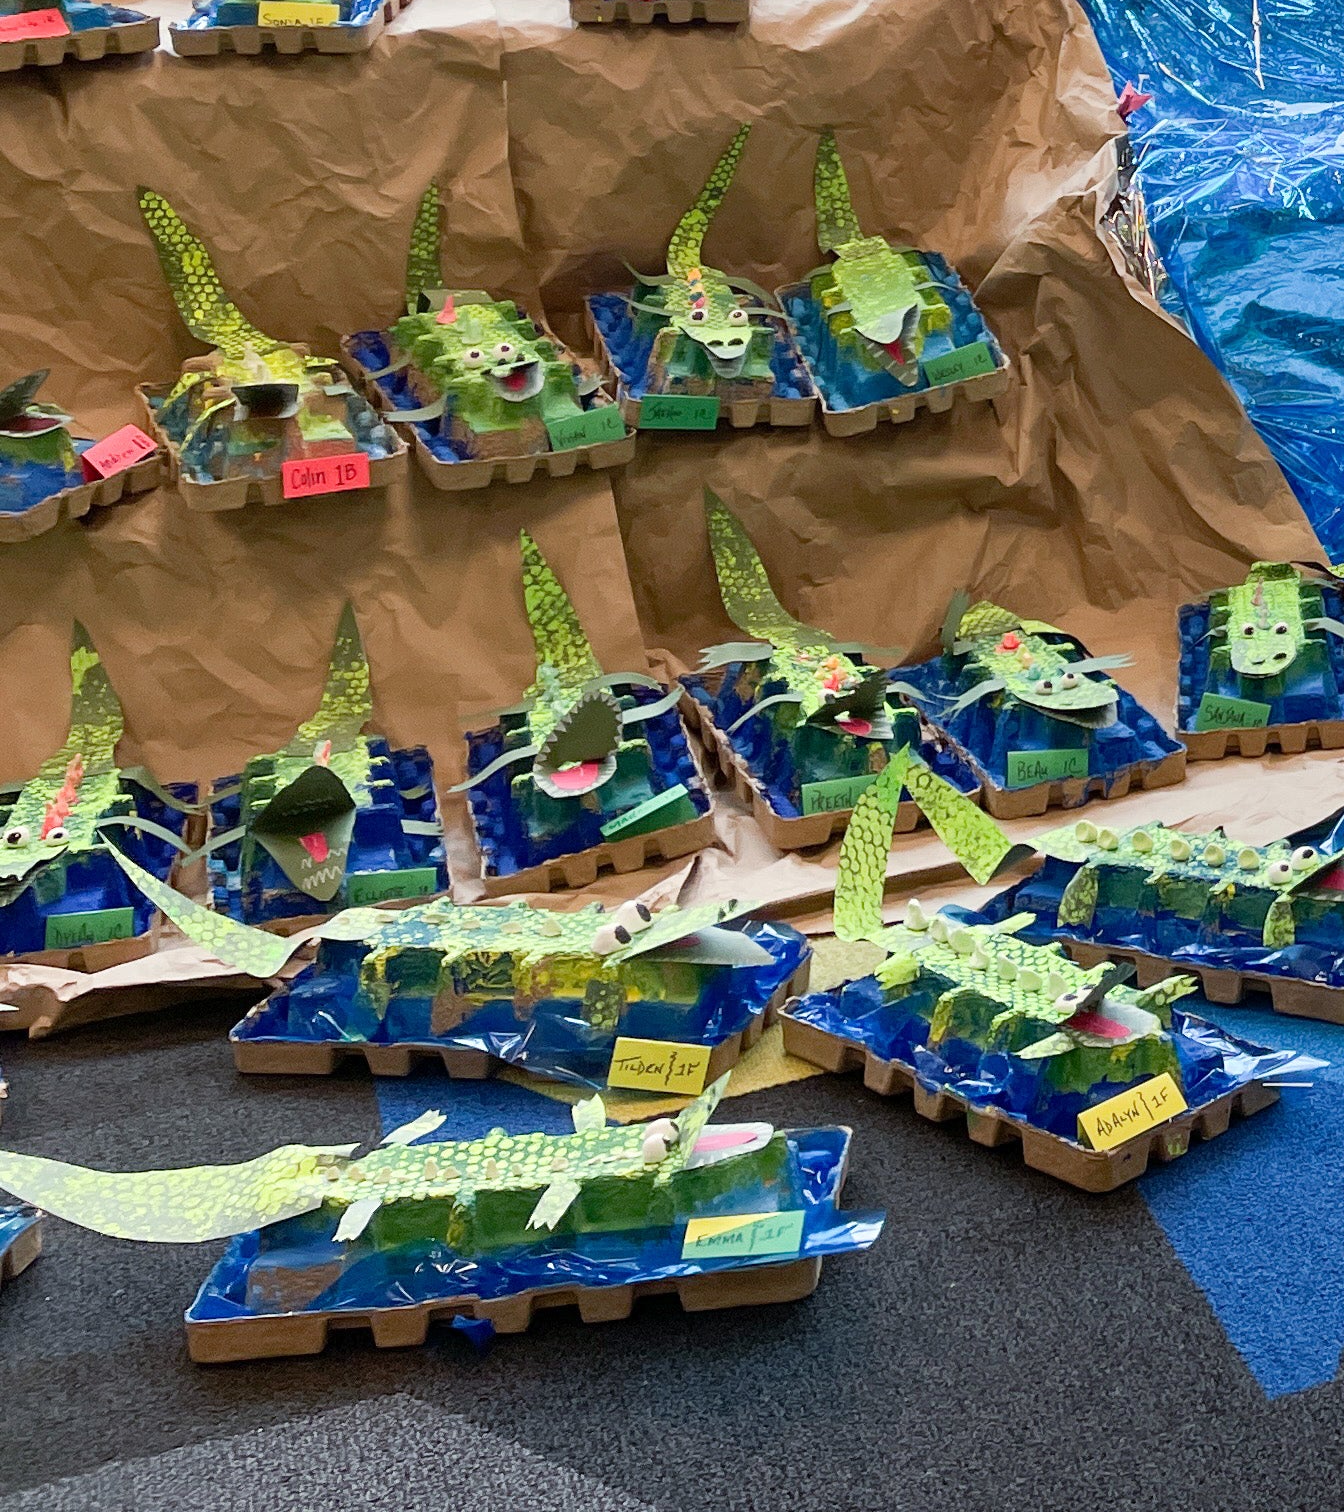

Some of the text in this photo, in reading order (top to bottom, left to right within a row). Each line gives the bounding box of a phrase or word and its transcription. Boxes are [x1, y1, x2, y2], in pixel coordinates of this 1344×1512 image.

[290, 462, 358, 490] Colin 1B
[674, 1060, 702, 1078] 1F
[1096, 1100, 1141, 1139] ADALYN
[1151, 1086, 1170, 1109] 1F
